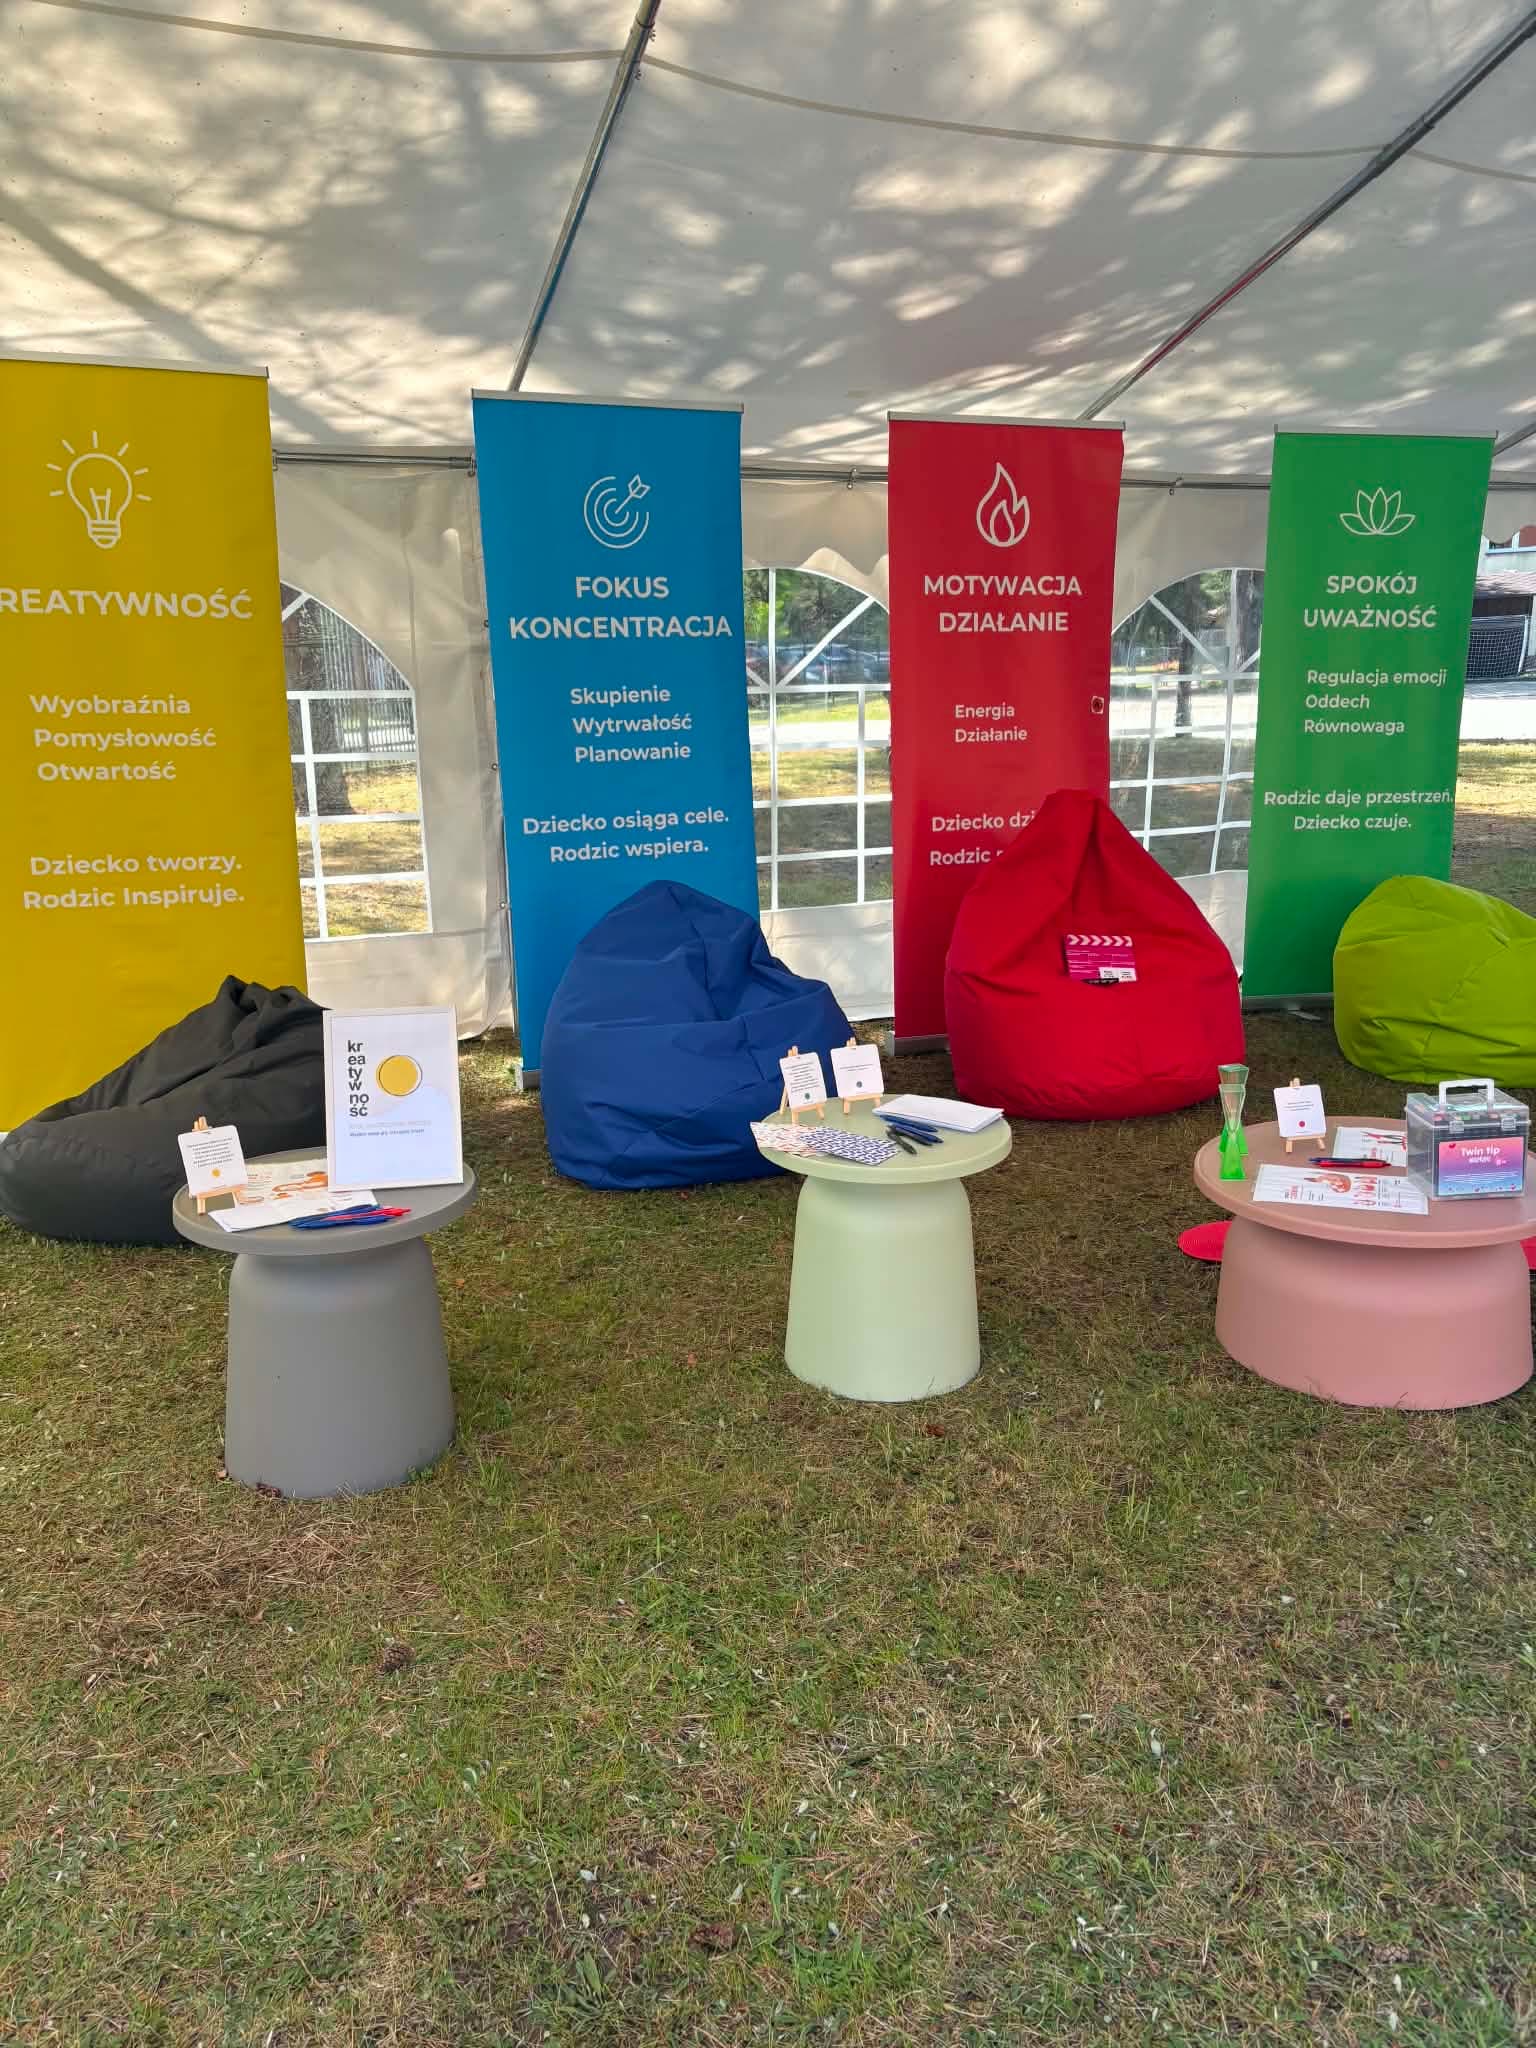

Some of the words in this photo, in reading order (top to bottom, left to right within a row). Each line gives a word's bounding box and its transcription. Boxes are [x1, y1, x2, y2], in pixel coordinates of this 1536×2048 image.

[576, 577, 669, 598] FOKUS
[925, 575, 1083, 595] MOTYWACJA
[1327, 572, 1416, 594] SPOKÓJ
[940, 612, 1068, 632] DZIAŁANIE
[1304, 604, 1437, 628] UWAŻNOŚĆ
[510, 616, 732, 639] KONCENTRACJA
[1308, 669, 1388, 687] Regulacja
[1393, 669, 1446, 686] emocji
[571, 684, 670, 706] Skupienie
[1306, 694, 1369, 708] Oddech
[30, 694, 191, 719] Wyobraźnia
[955, 703, 1014, 720] Energia
[572, 714, 691, 736] Wytrwałość
[955, 726, 1027, 742] Działanie
[1305, 719, 1404, 735] Równowaga
[34, 728, 216, 751] Pomysłowość
[576, 742, 690, 762] Planowanie
[38, 761, 176, 781] Otwartość
[1264, 790, 1321, 805] Rodzic
[1325, 789, 1361, 807] daje
[523, 814, 606, 834] Dziecko
[613, 812, 678, 831] osiąga
[685, 806, 728, 824] cele.
[932, 813, 1004, 832] Dziecko
[1294, 814, 1360, 830] Dziecko
[1365, 815, 1411, 831] czuje.
[551, 842, 619, 862] Rodzic
[625, 837, 708, 859] wspiera.
[930, 848, 990, 865] Rodzic
[31, 855, 139, 875] Dziecko
[147, 854, 241, 874] tworzy.
[24, 887, 114, 908] Rodzic
[124, 884, 244, 908] Inspiruje.
